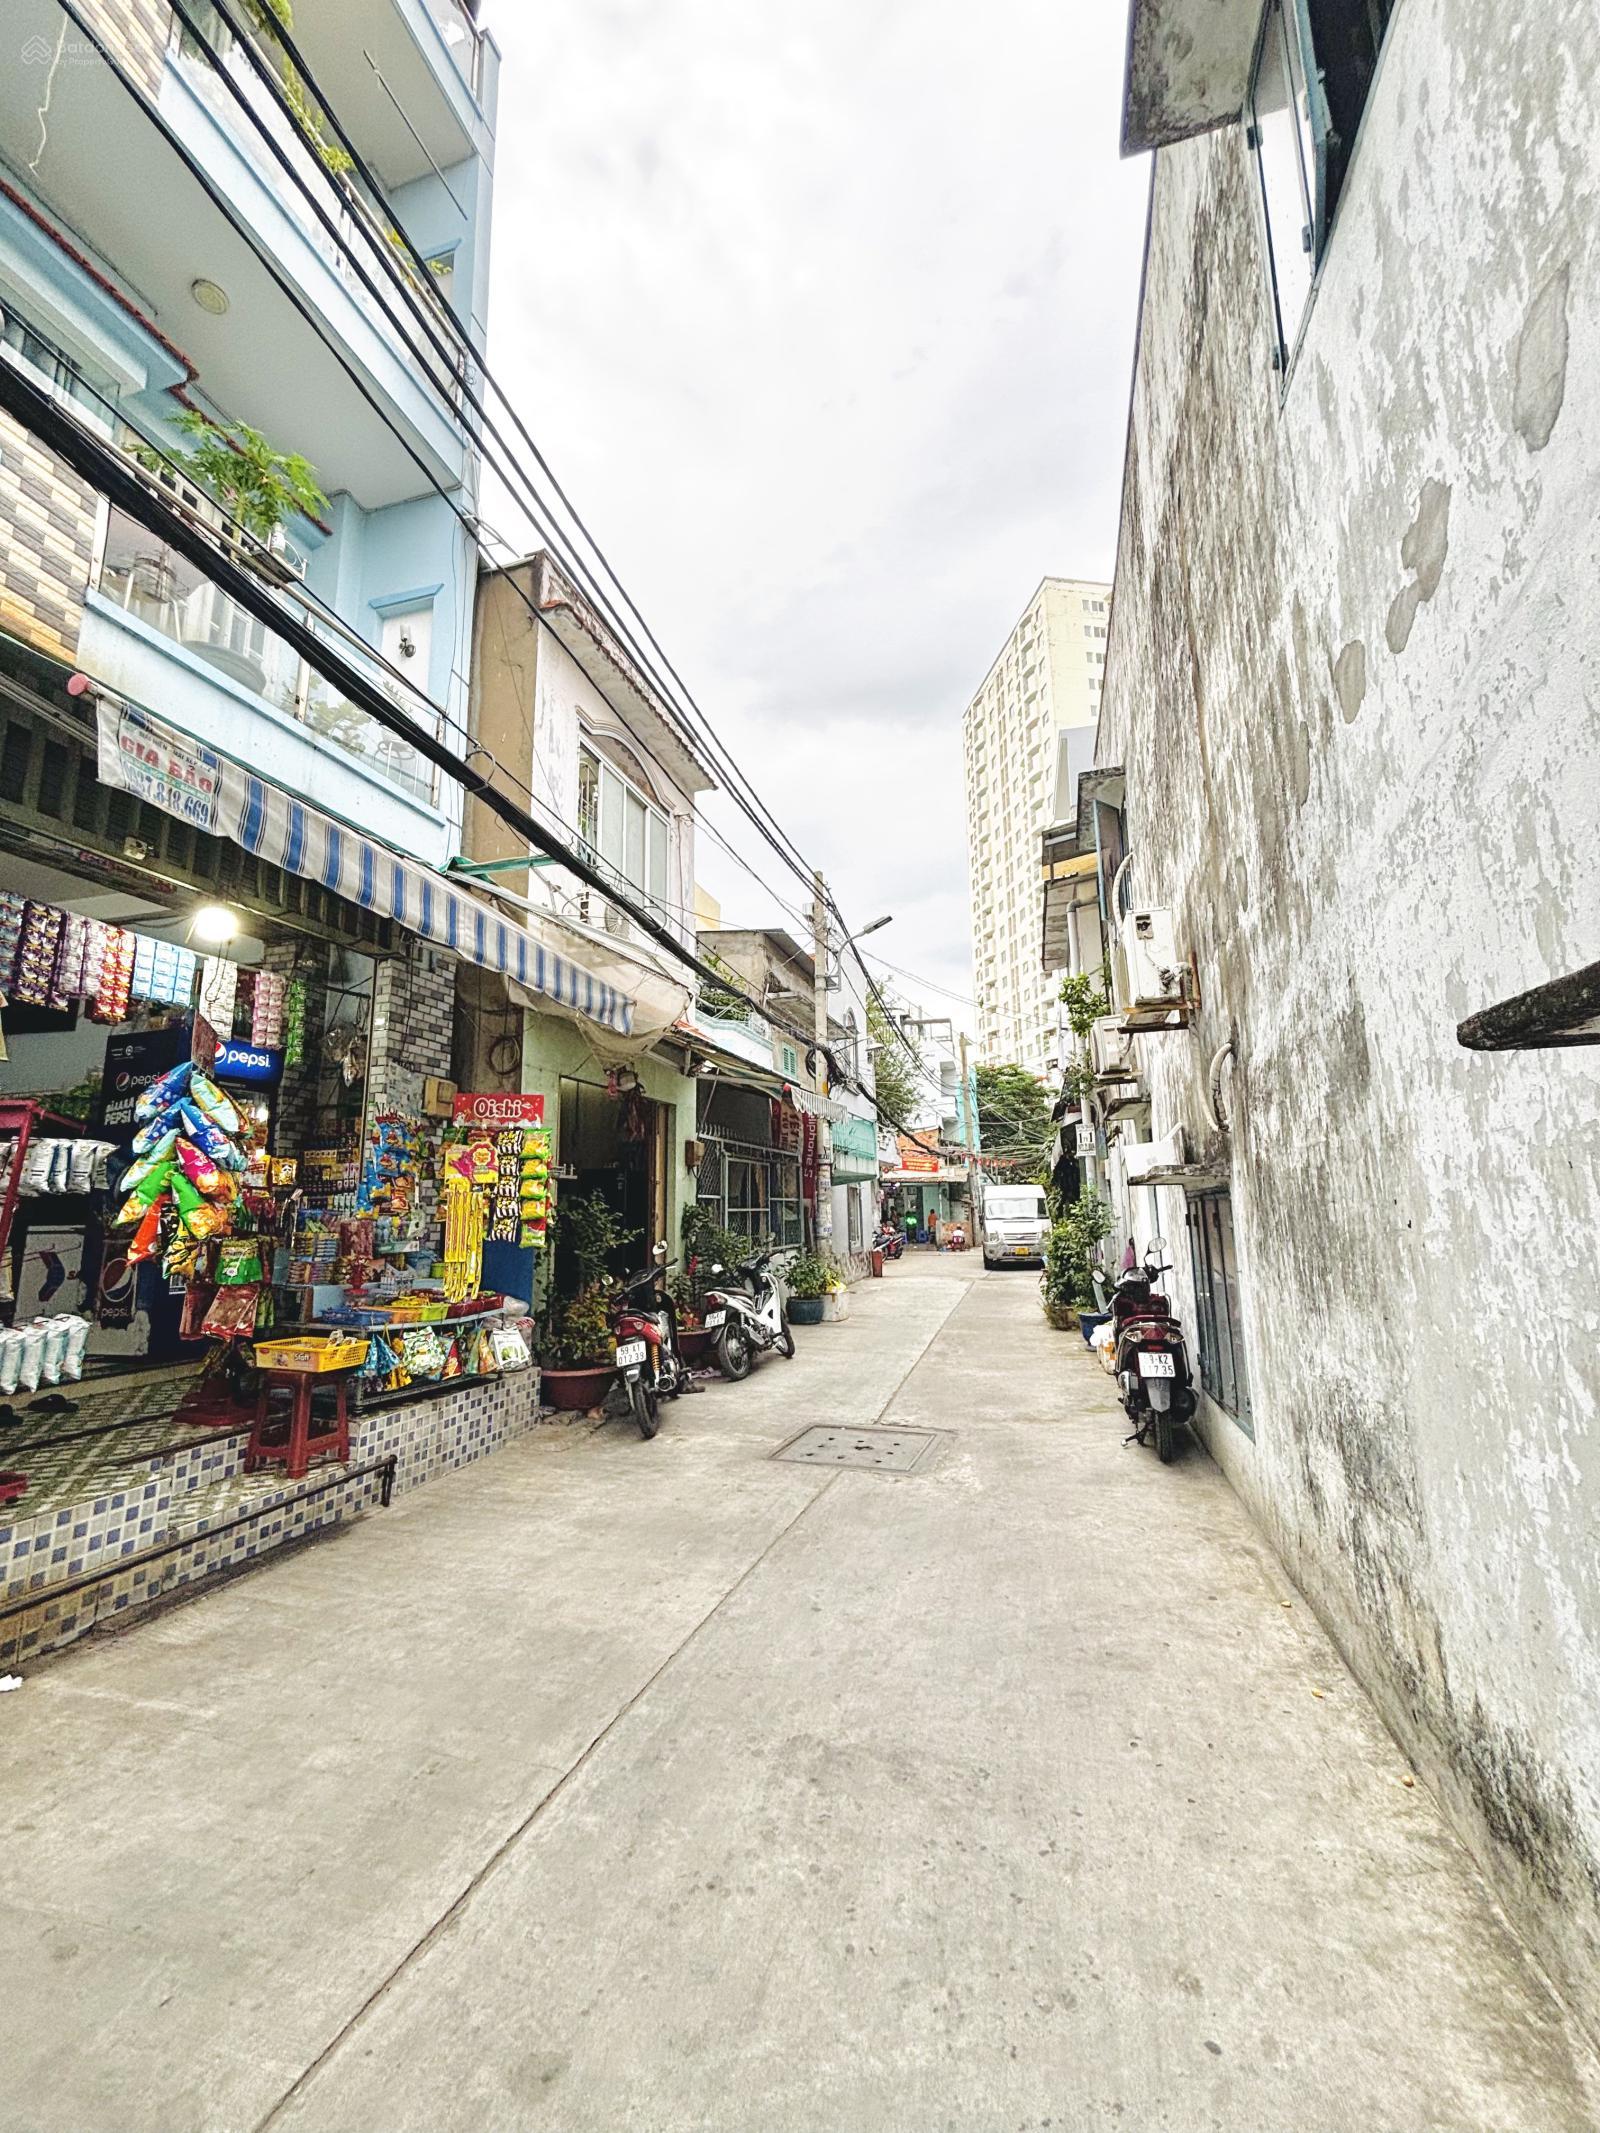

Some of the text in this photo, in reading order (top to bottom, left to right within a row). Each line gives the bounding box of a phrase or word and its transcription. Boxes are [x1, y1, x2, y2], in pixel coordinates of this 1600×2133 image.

[121, 735, 160, 769] GIA
[168, 763, 213, 794] BẢO
[227, 1050, 269, 1067] pepsi
[131, 1072, 160, 1088] peps
[474, 1097, 522, 1118] Oishi
[104, 1109, 132, 1126] PEPSI
